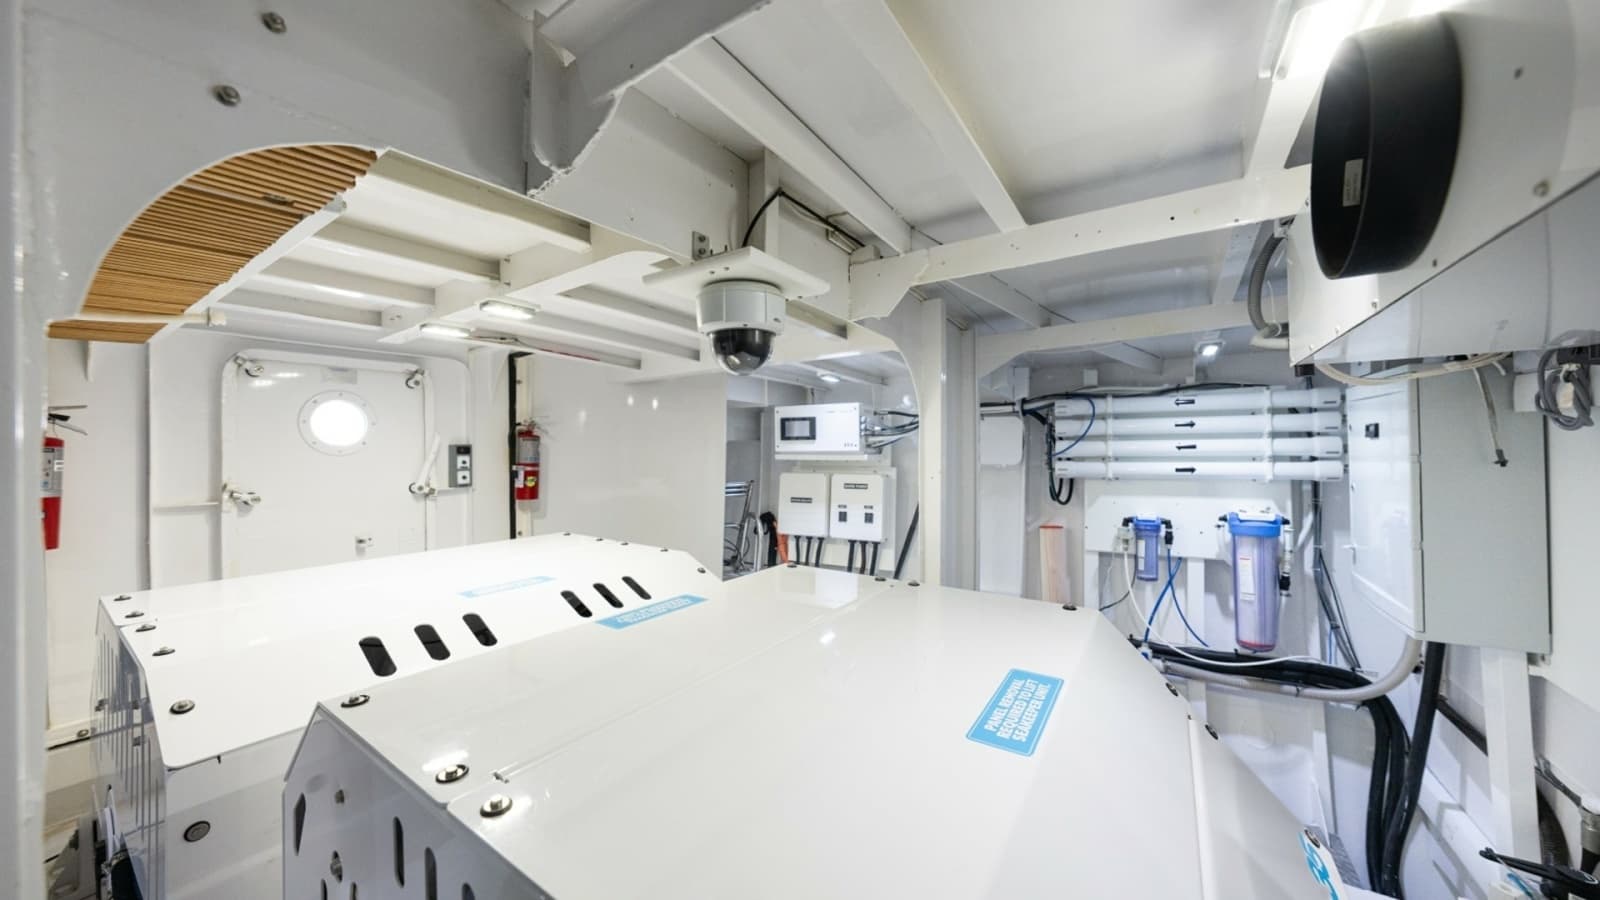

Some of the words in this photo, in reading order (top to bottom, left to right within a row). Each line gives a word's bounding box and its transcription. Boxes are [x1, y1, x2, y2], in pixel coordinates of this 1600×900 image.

[1017, 690, 1032, 701] TO
[1022, 679, 1039, 692] LIFT
[983, 708, 1009, 733] PANEL
[997, 679, 1026, 708] REMOVAL
[996, 700, 1027, 739] REQUIRED
[1012, 700, 1043, 742] SEAKEEPER
